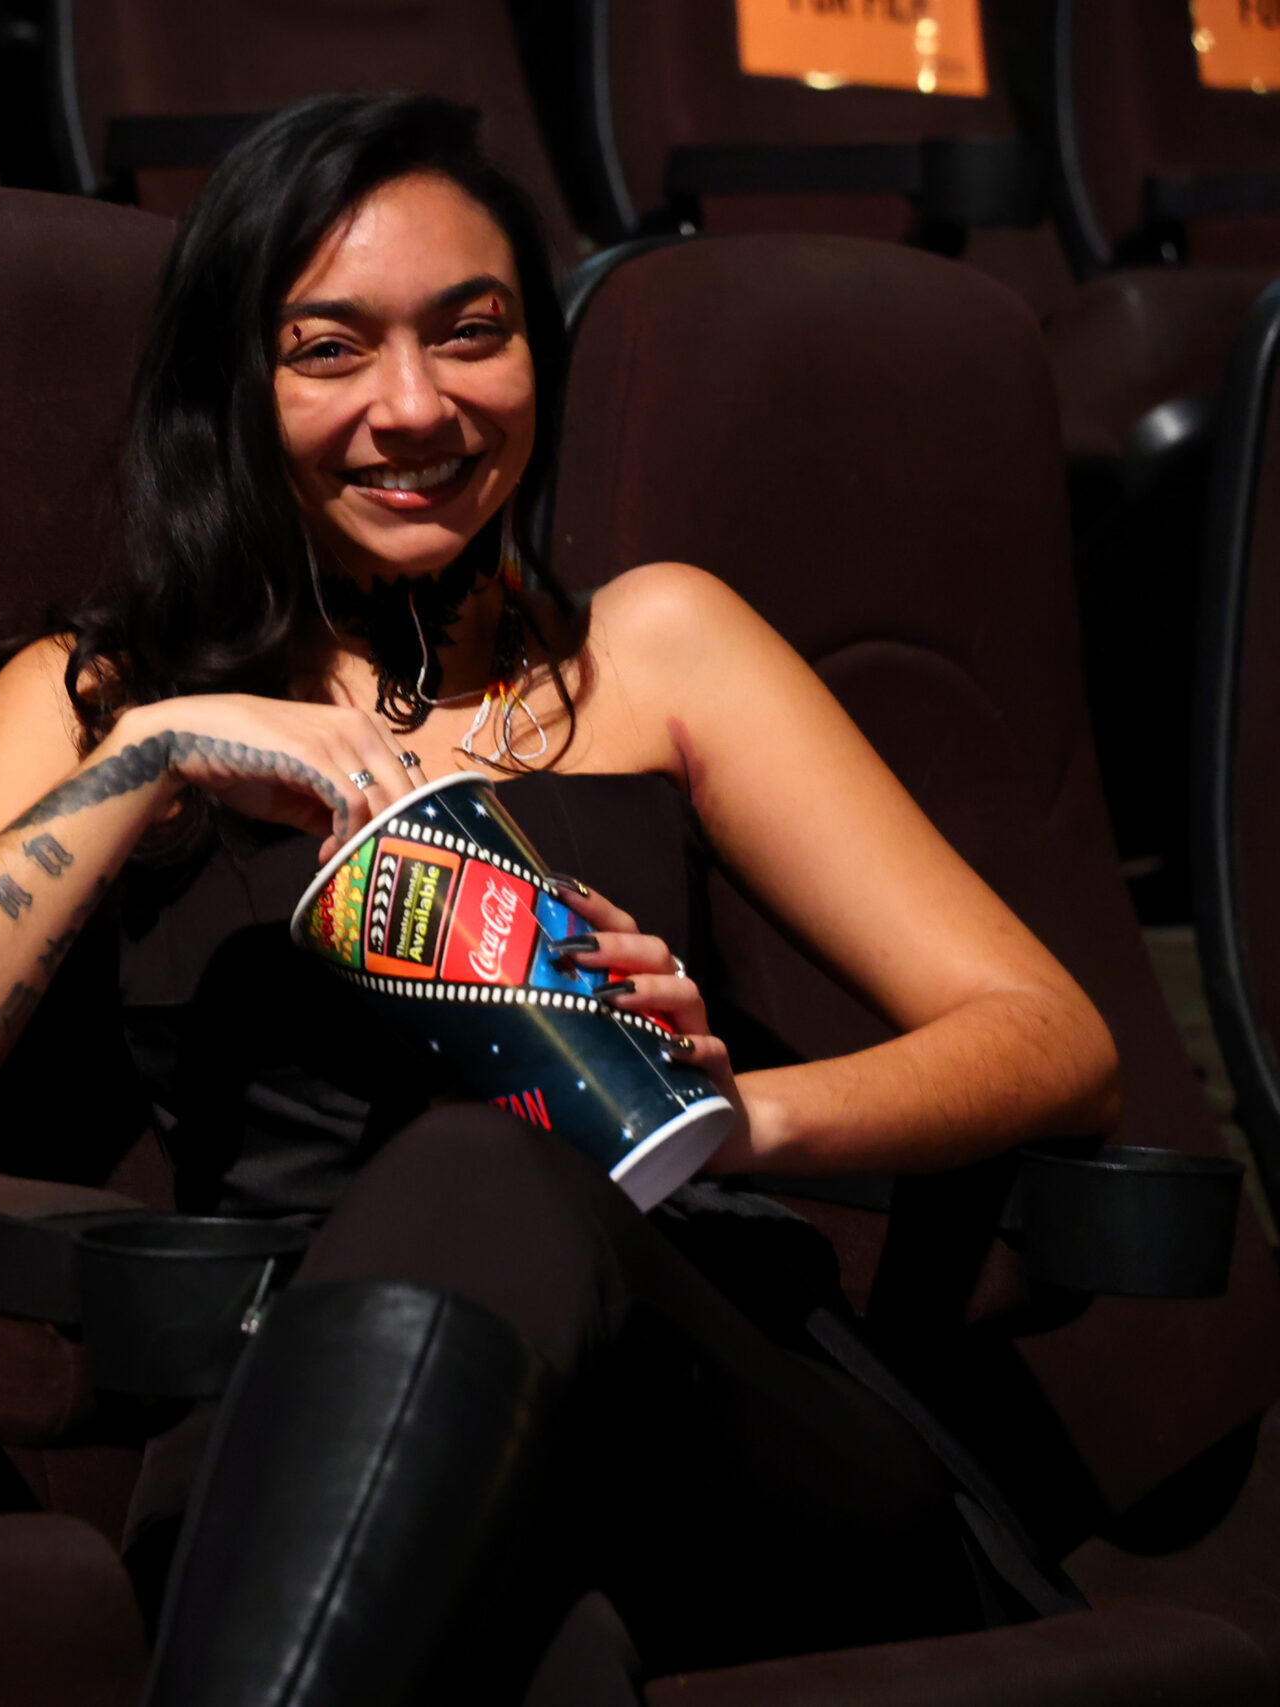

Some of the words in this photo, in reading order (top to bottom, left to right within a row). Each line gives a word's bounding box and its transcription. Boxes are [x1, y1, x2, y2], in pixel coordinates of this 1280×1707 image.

[319, 874, 337, 949] POPCO
[396, 908, 410, 957] Theatre
[409, 865, 440, 963] Available
[469, 877, 518, 982] Coca-Cola
